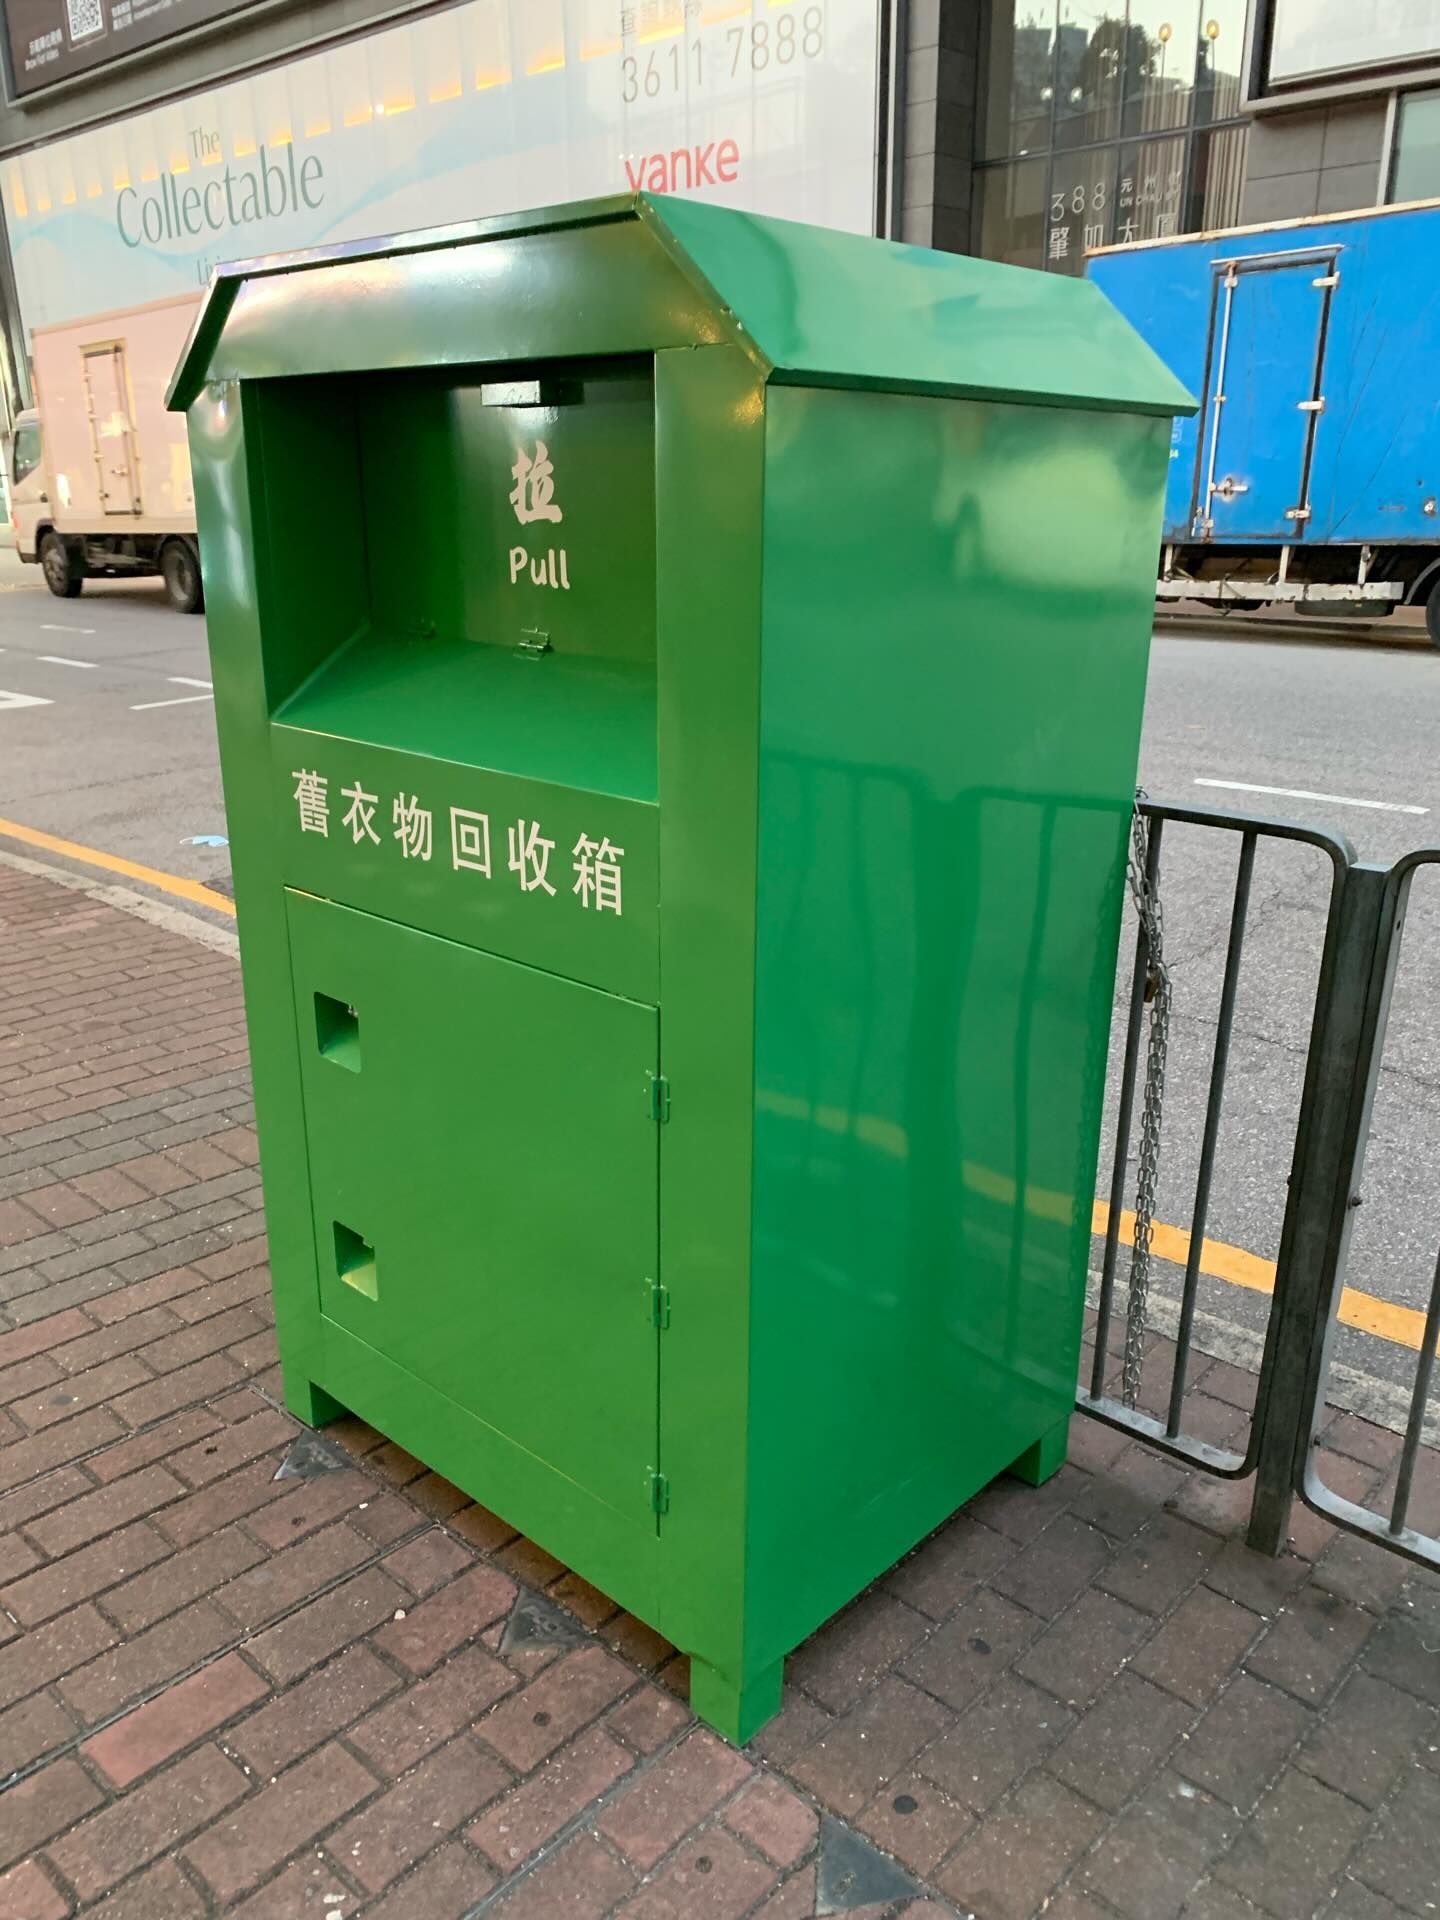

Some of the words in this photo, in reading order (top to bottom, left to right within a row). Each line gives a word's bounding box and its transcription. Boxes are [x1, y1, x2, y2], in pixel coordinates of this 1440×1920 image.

[621, 38, 703, 104] 3611
[726, 6, 823, 79] 7888
[189, 125, 221, 159] The
[624, 138, 740, 194] vanke
[116, 141, 326, 248] Collectable
[1050, 182, 1106, 222] 388
[509, 439, 563, 525] 拉
[509, 546, 571, 590] Pull
[292, 768, 625, 916] 舊衣物回收箱
